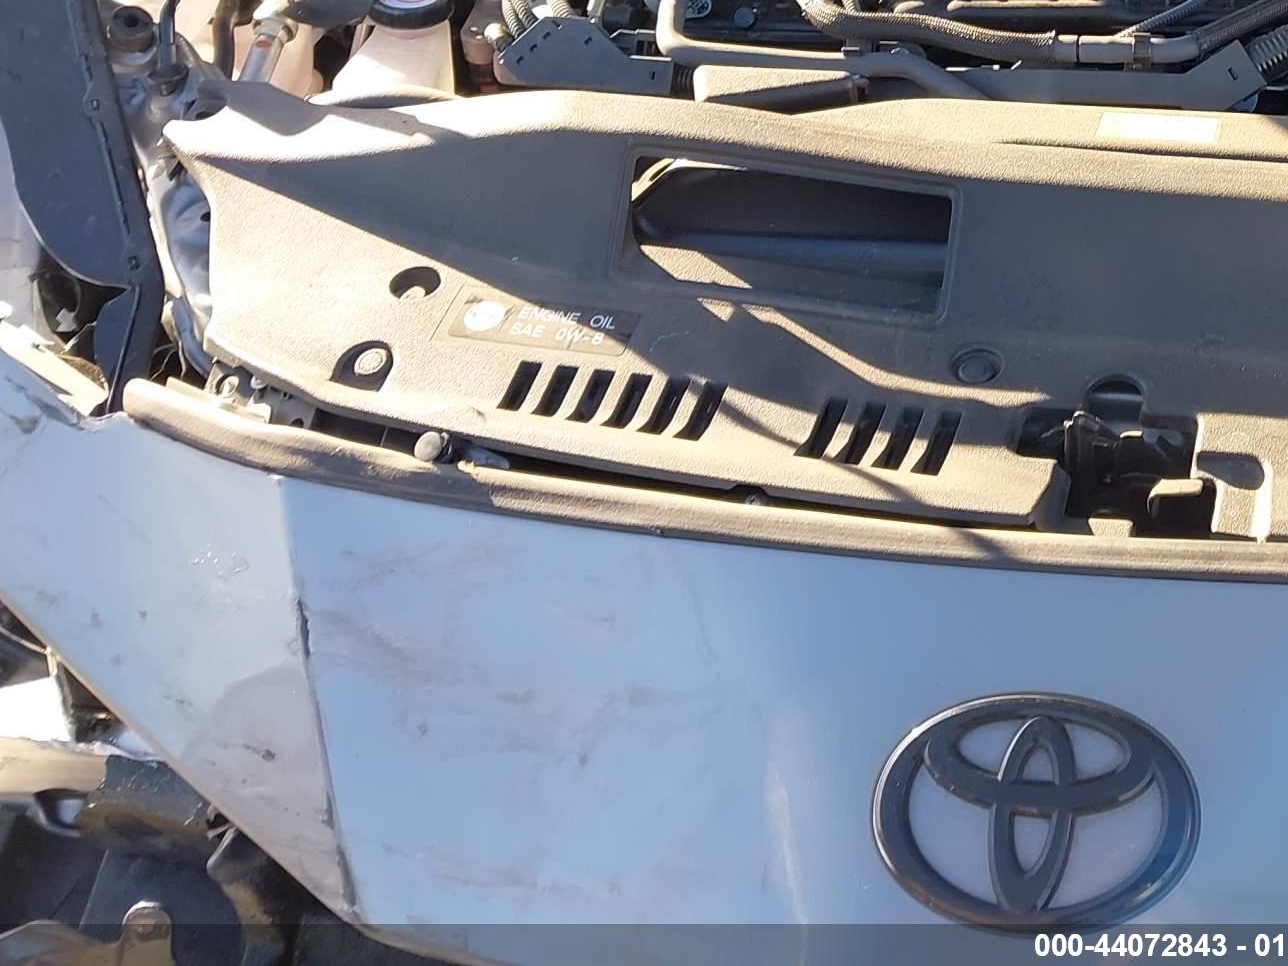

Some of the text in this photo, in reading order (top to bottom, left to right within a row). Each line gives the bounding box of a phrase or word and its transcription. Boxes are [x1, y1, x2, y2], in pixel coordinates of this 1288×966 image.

[517, 307, 616, 330] ENGINE OIL
[510, 322, 545, 339] SAE
